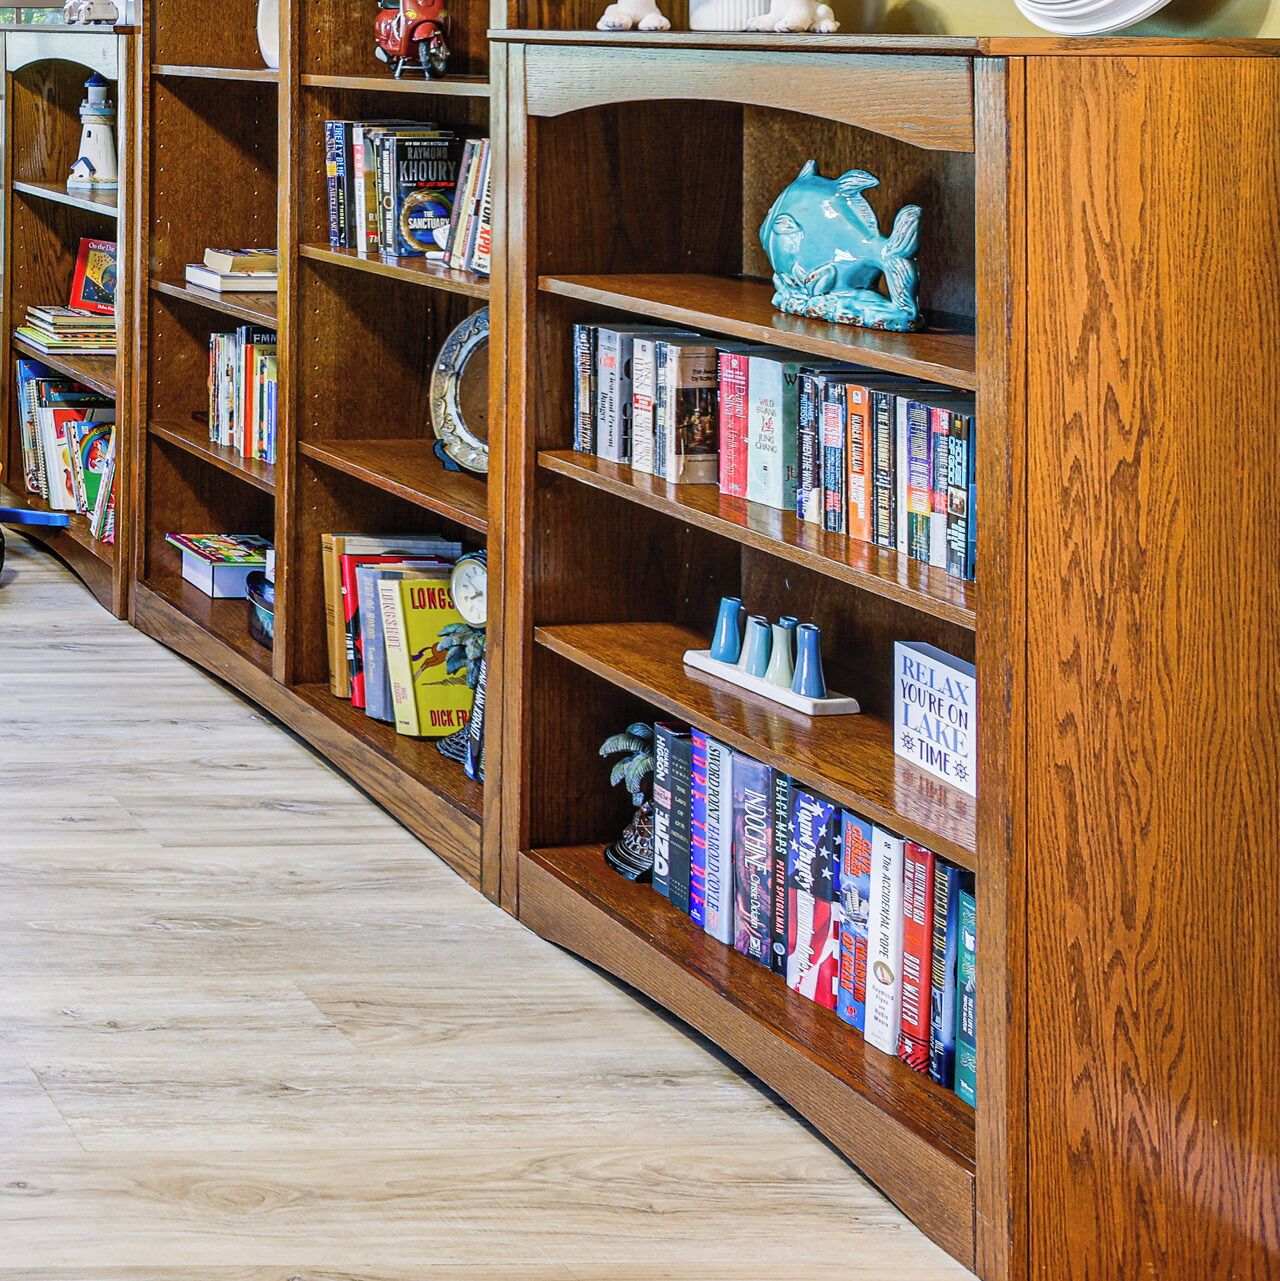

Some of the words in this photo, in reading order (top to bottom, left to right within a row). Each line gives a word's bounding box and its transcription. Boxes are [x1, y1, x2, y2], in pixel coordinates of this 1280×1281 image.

[334, 123, 345, 155] FIREFLY
[408, 147, 448, 160] RAYMOND
[336, 156, 345, 177] BLUE
[400, 160, 456, 181] KHOURY
[408, 218, 450, 229] SANCTUARY
[88, 242, 98, 250] On
[478, 227, 491, 255] XPD
[608, 372, 616, 394] Clear
[635, 357, 644, 390] FLYNN
[644, 361, 652, 389] VINCE
[600, 391, 608, 424] Danger
[725, 395, 735, 416] Silva
[735, 385, 746, 419] Daniel
[758, 397, 774, 407] WILD
[800, 394, 808, 427] PATTERSON
[608, 413, 616, 448] Present
[635, 413, 643, 465] OPTION
[758, 433, 774, 444] JUNG
[802, 434, 813, 457] WHEN
[851, 415, 863, 443] ROBERT
[755, 441, 777, 454] CHANG
[802, 456, 812, 471] THE
[851, 443, 864, 472] LUDLUM
[802, 470, 813, 491] WIND
[948, 455, 956, 485] GOD
[410, 588, 455, 610] LONGS
[381, 588, 401, 651] LONGSHOT
[902, 654, 969, 706] RELAX
[474, 685, 485, 709] ANN
[900, 679, 944, 719] YOU'RE
[948, 704, 969, 730] ON
[430, 709, 454, 726] DICK
[470, 706, 482, 740] KRENTZ
[903, 702, 969, 759] LAKE
[656, 734, 666, 782] HIGSON
[708, 746, 721, 788] SWORD
[917, 738, 950, 776] TIME
[708, 788, 721, 823] POINT
[776, 778, 787, 816] BLACK
[744, 788, 767, 875] INDOCHINE
[799, 799, 818, 838] Tom
[707, 823, 721, 871] HAROLD
[775, 821, 787, 855] MAPS
[851, 825, 862, 878] CUSSLER
[776, 859, 785, 884] PETER
[794, 837, 817, 893] Clancy
[861, 839, 872, 875] CLIVE
[882, 855, 892, 871] The
[707, 872, 720, 912] COYLE
[880, 872, 891, 930] ACCIDENTAL
[935, 869, 948, 914] OFFICER
[776, 885, 785, 935] SPIEGELMAN
[934, 916, 947, 932] OF
[841, 931, 854, 950] OF
[879, 931, 890, 959] POPE
[933, 932, 947, 952] THE
[841, 951, 853, 994] KHAN
[854, 935, 867, 1003] TREASURE
[903, 951, 920, 982] BONE
[932, 953, 946, 991] COURT
[902, 982, 919, 1026] WALKER
[934, 1039, 944, 1056] BILL
